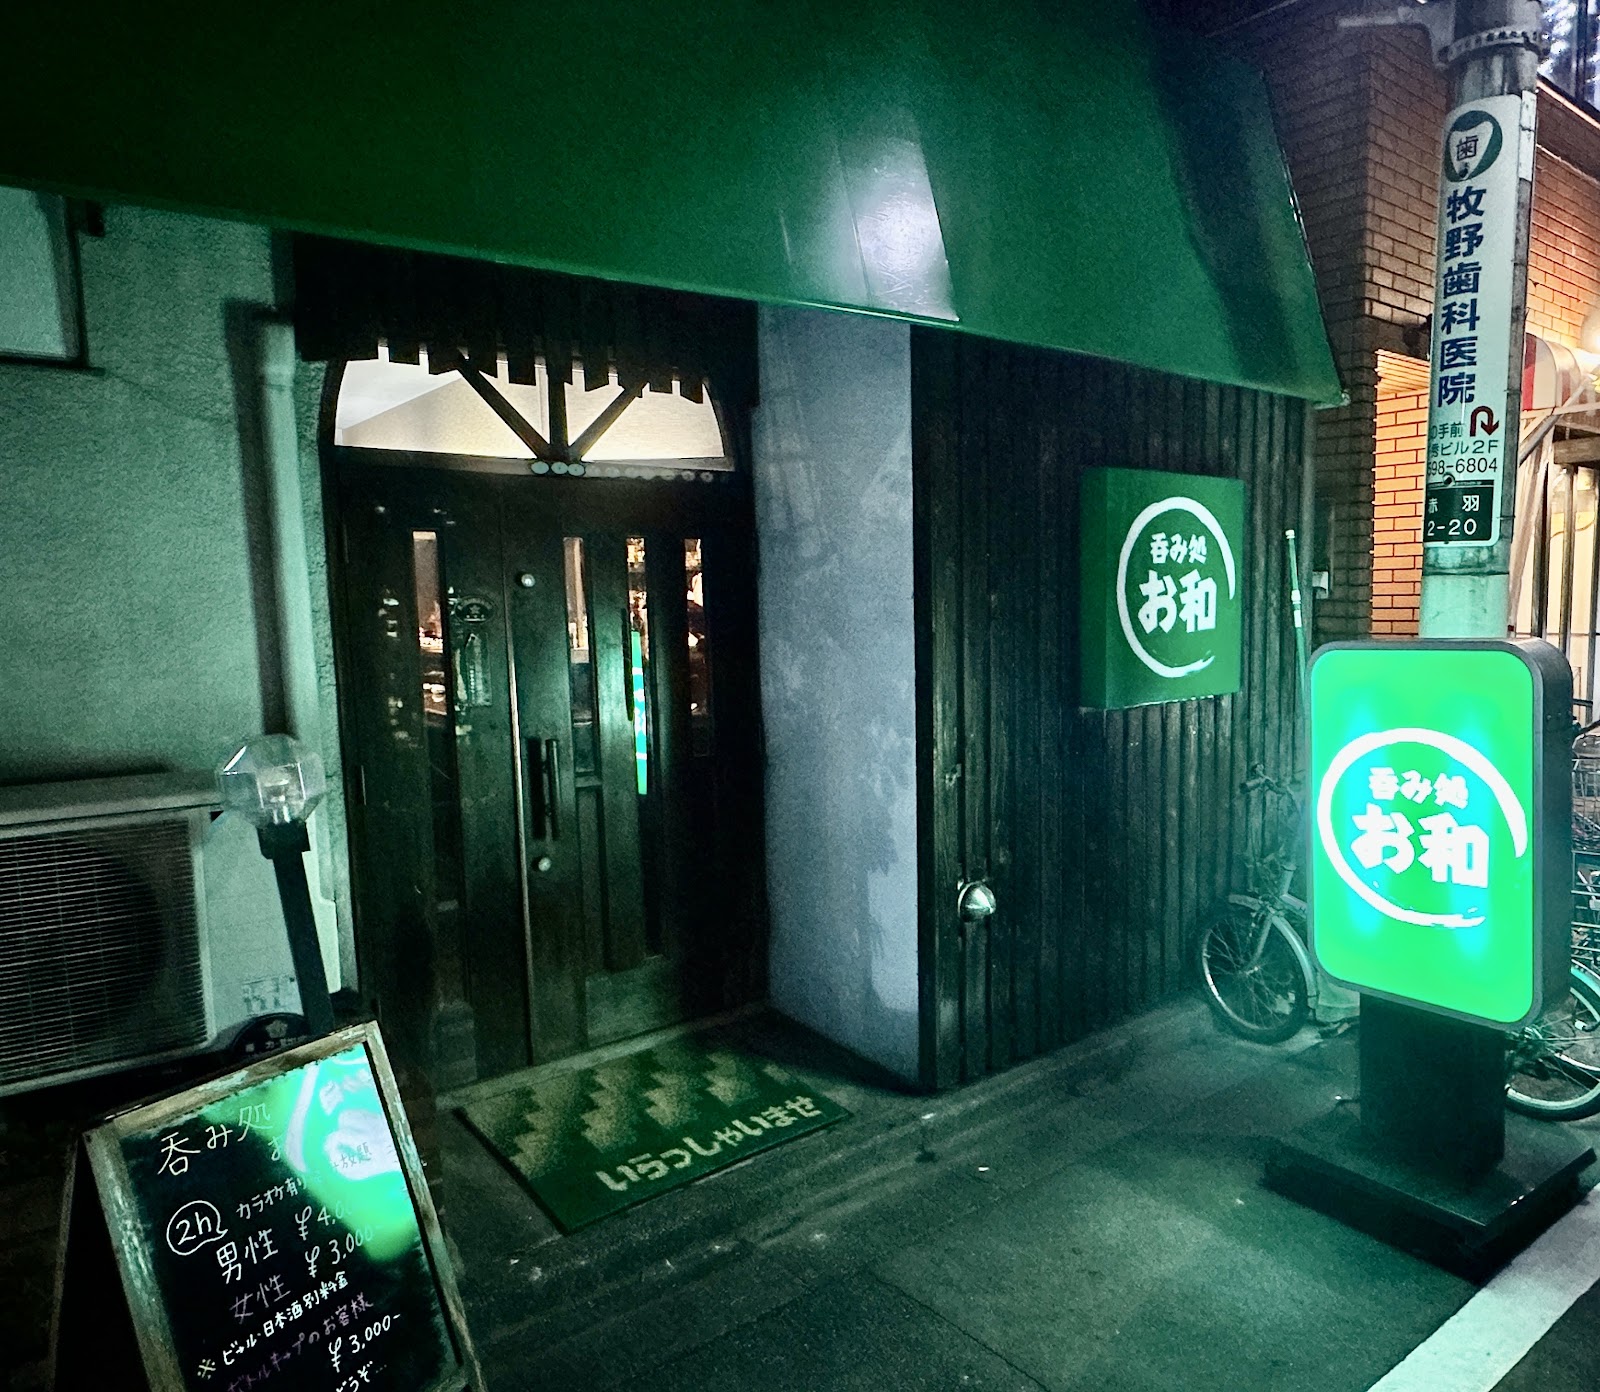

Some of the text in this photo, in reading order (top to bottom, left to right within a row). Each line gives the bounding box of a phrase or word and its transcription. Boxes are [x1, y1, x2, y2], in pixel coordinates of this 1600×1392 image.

[1455, 135, 1479, 162] 歯
[1437, 186, 1487, 408] 牧野歯科医院
[1150, 532, 1208, 564] 呑み処
[1426, 518, 1477, 537] 2-20
[1138, 569, 1218, 634] お和
[1368, 767, 1469, 810] 呑み処
[1350, 802, 1490, 889] お和
[157, 1102, 274, 1176] 呑み処
[595, 1094, 822, 1192] いらっしゃいませ
[175, 1211, 212, 1246] 2h
[215, 1227, 279, 1285] 男性
[229, 1273, 292, 1325] 女性
